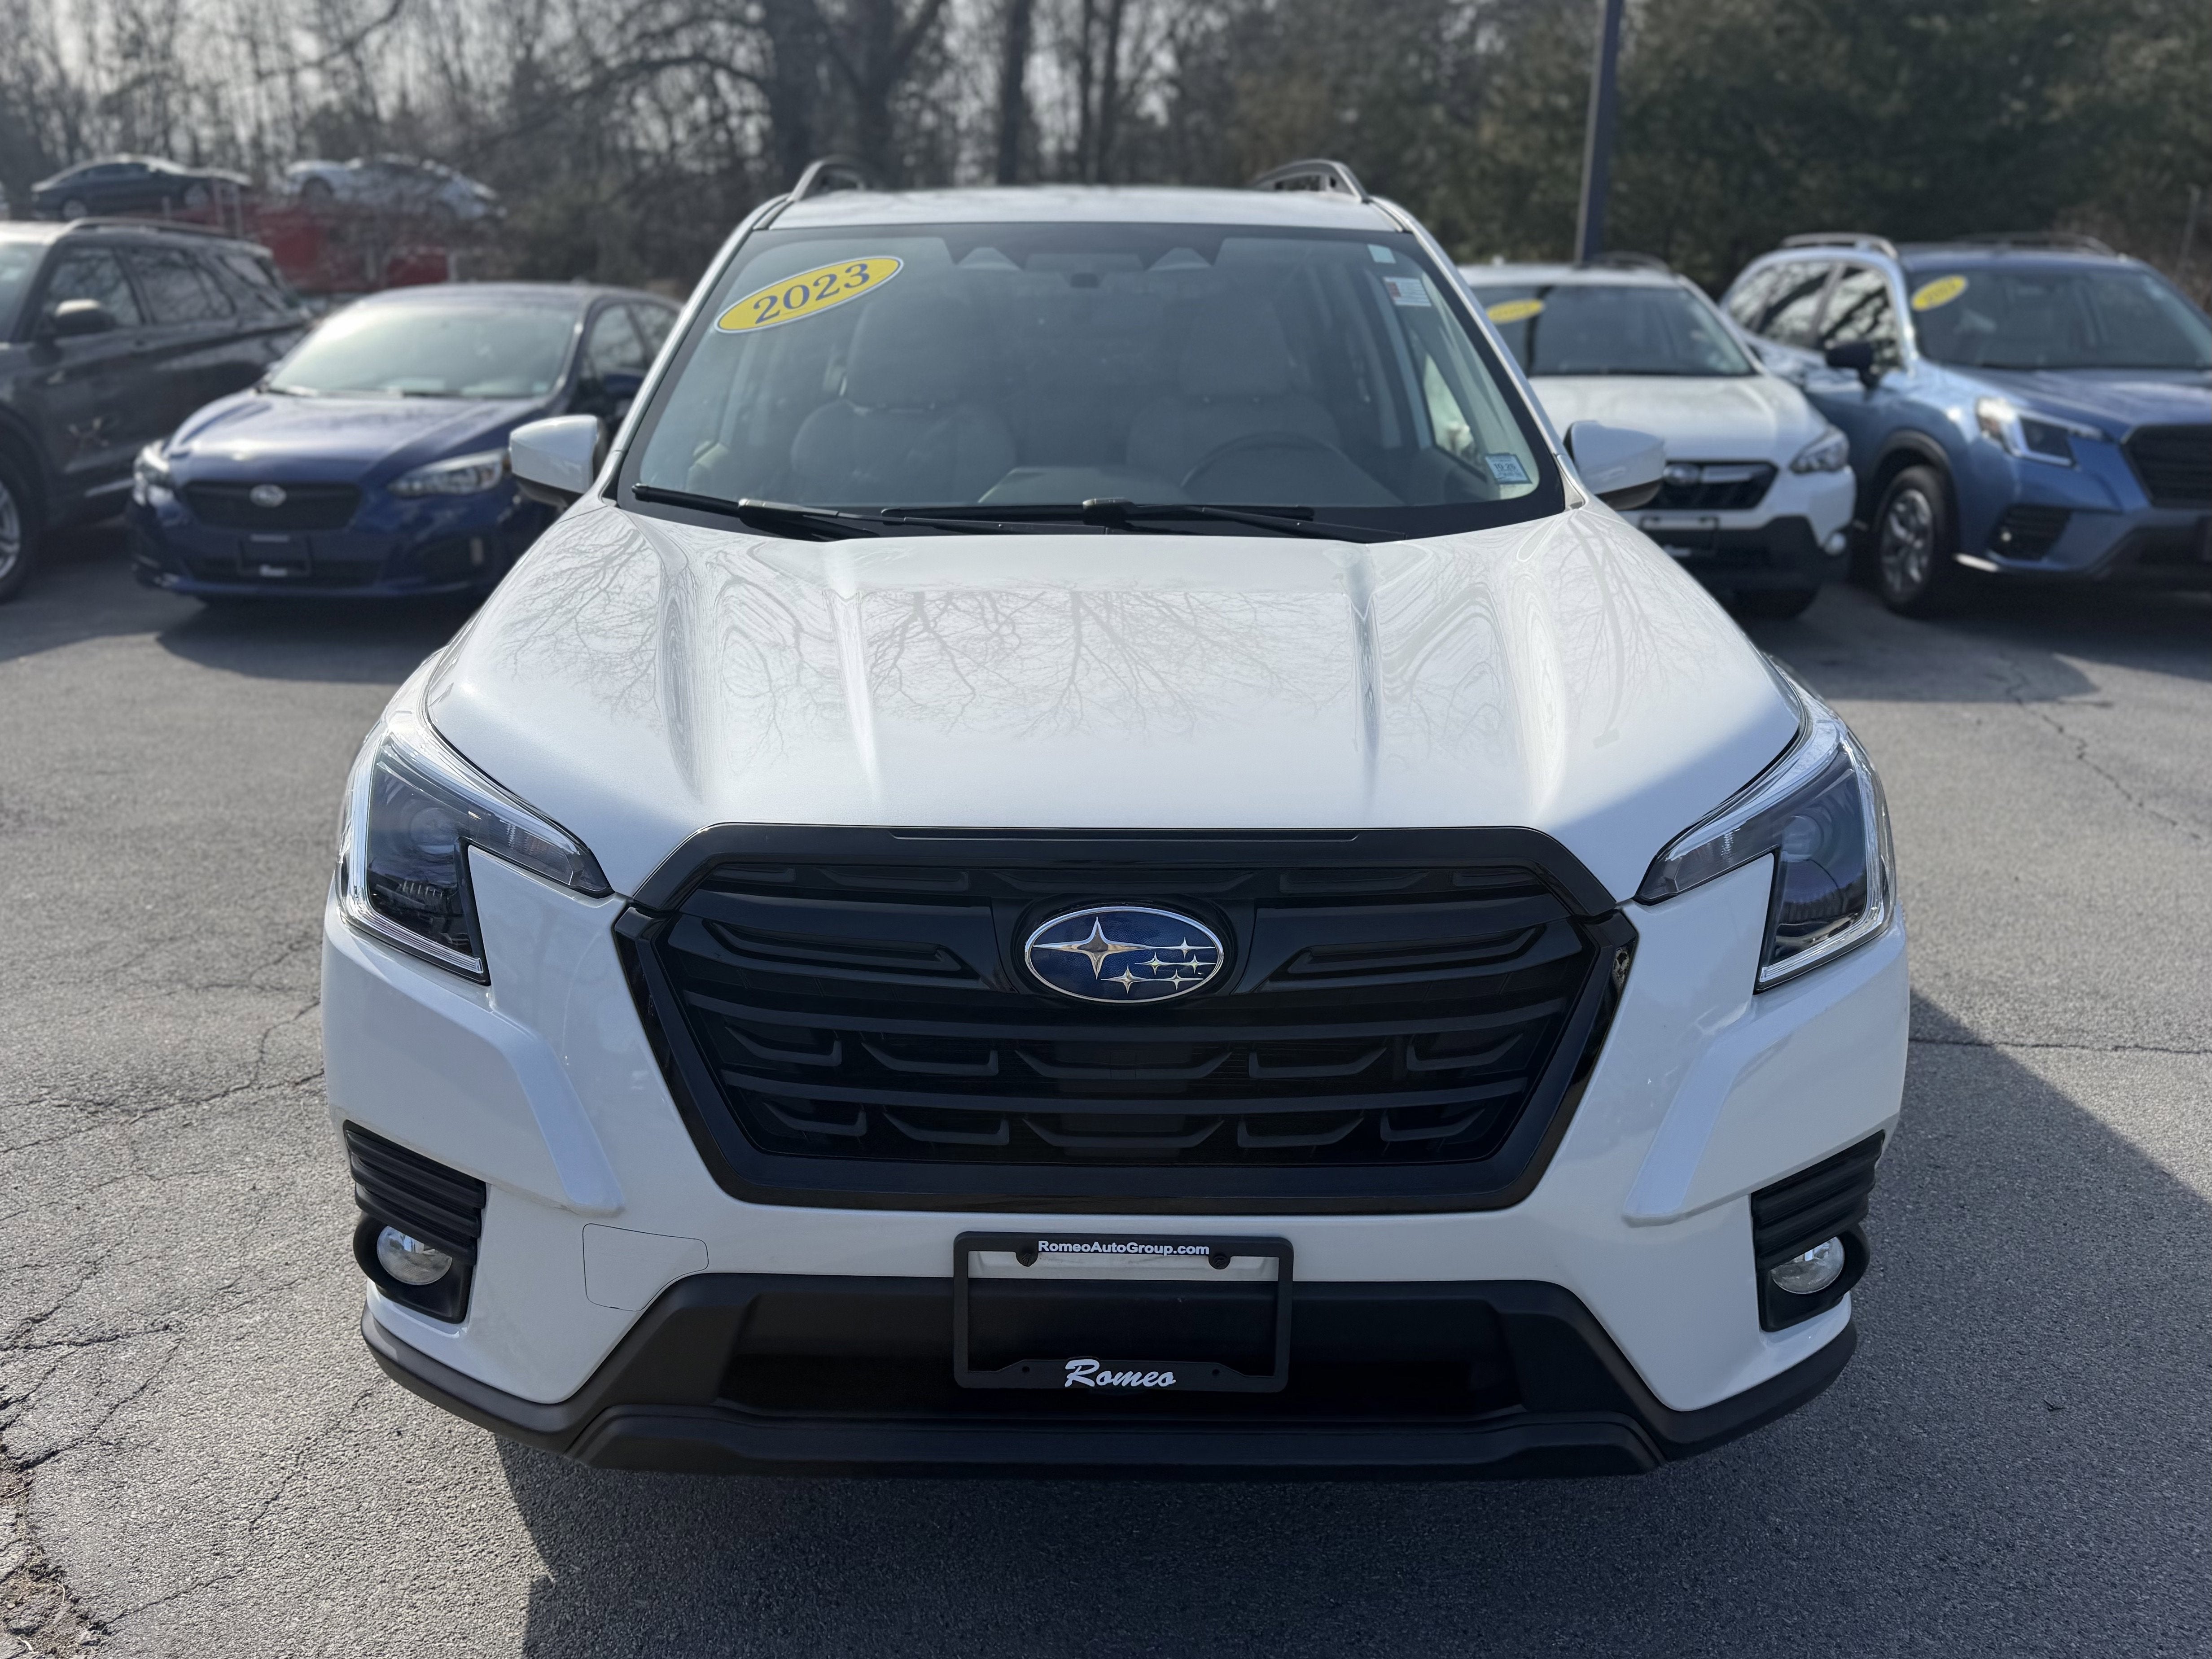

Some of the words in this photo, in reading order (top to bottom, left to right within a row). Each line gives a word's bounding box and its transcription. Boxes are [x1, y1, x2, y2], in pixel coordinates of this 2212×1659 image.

[753, 263, 870, 324] 2023
[1038, 1241, 1209, 1256] RomeoAutoGroup.com
[1065, 1359, 1176, 1387] Romeo
